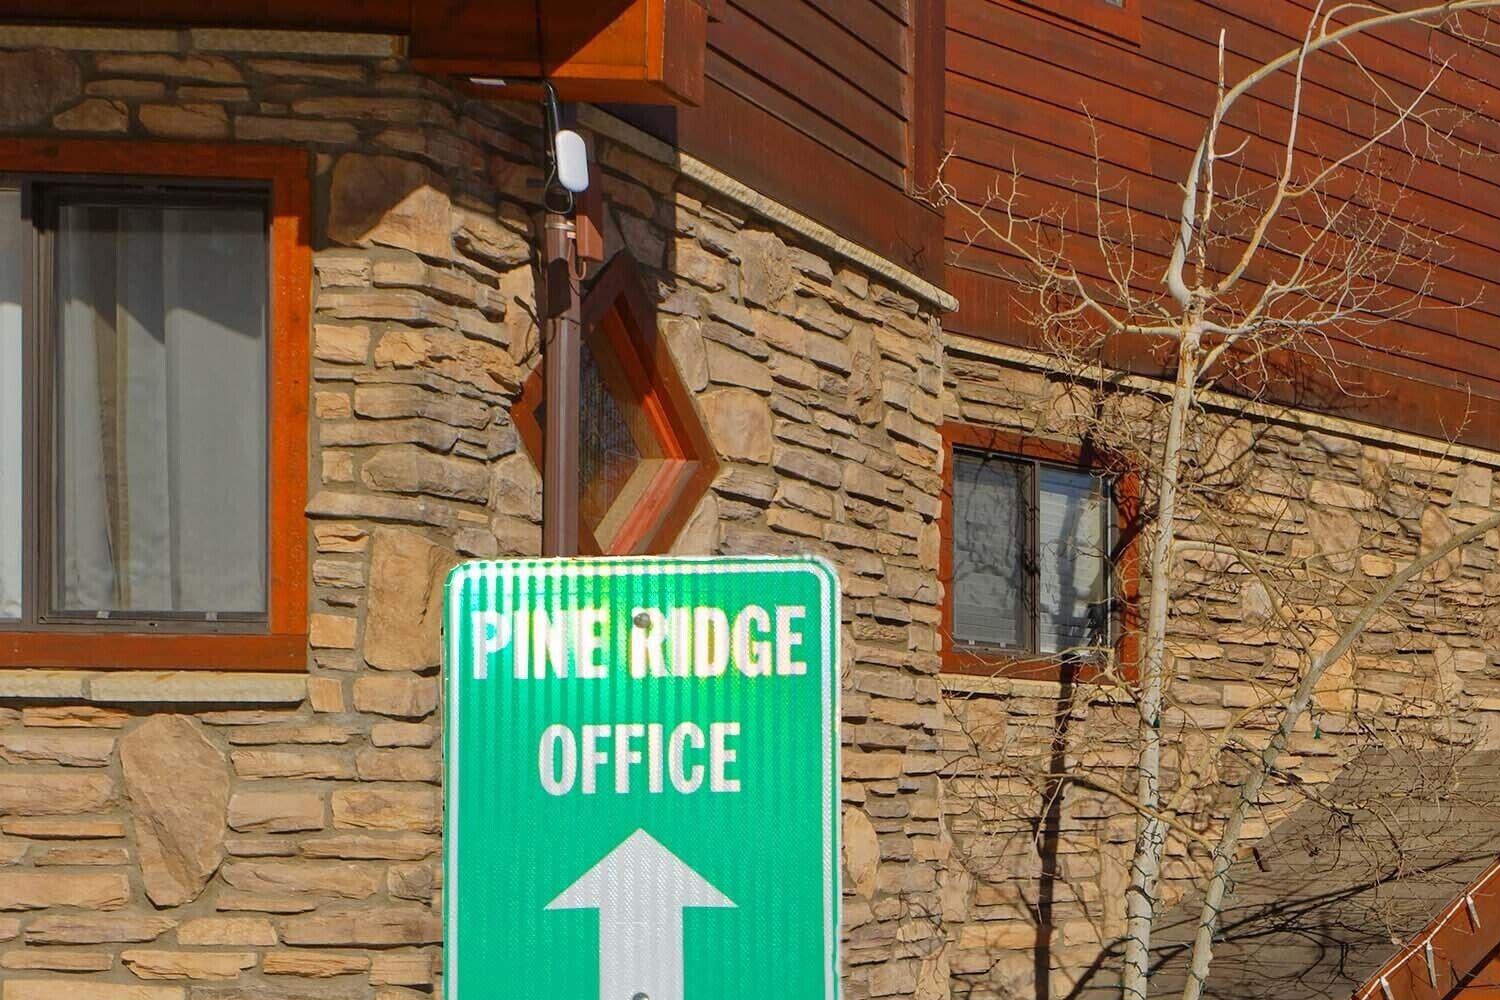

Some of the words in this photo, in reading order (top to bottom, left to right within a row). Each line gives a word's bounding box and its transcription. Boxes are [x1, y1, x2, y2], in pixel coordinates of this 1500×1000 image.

[471, 608, 609, 680] PINE
[630, 605, 807, 679] RIDGE
[538, 721, 742, 796] OFFICE
